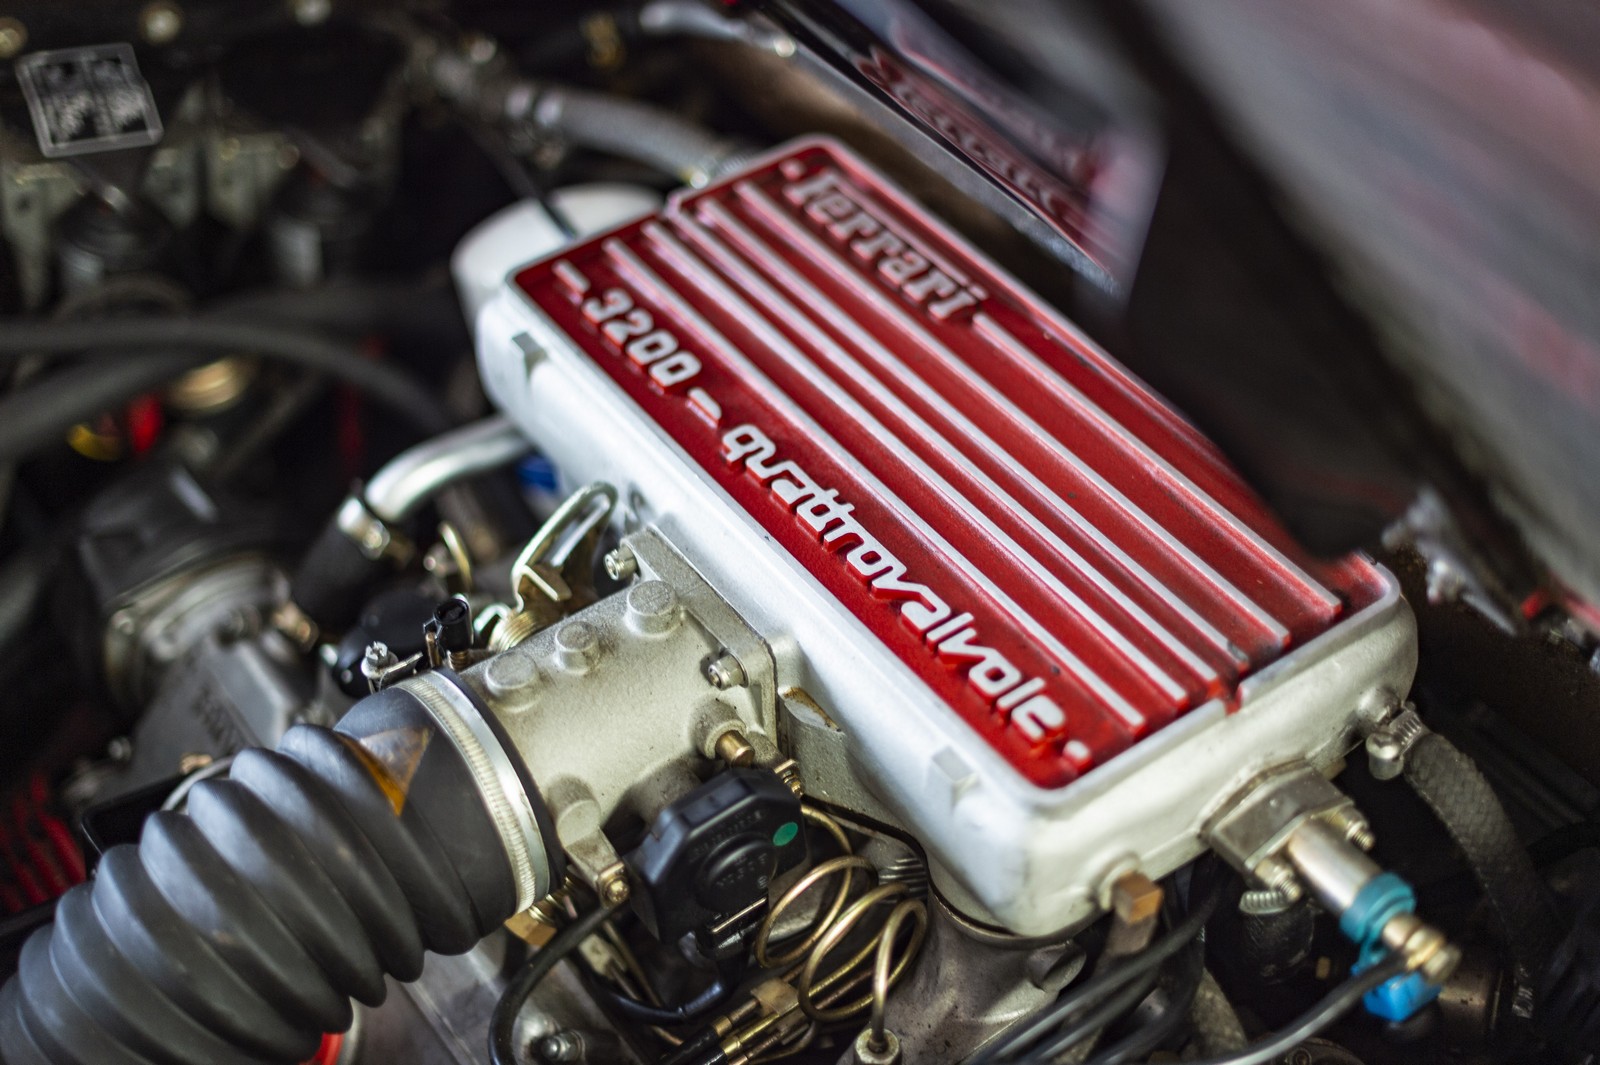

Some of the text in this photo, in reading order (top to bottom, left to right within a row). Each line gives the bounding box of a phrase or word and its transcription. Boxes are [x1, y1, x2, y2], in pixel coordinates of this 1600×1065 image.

[783, 167, 988, 322] Ferrari
[581, 287, 1066, 742] 3200 quattrovalvole
